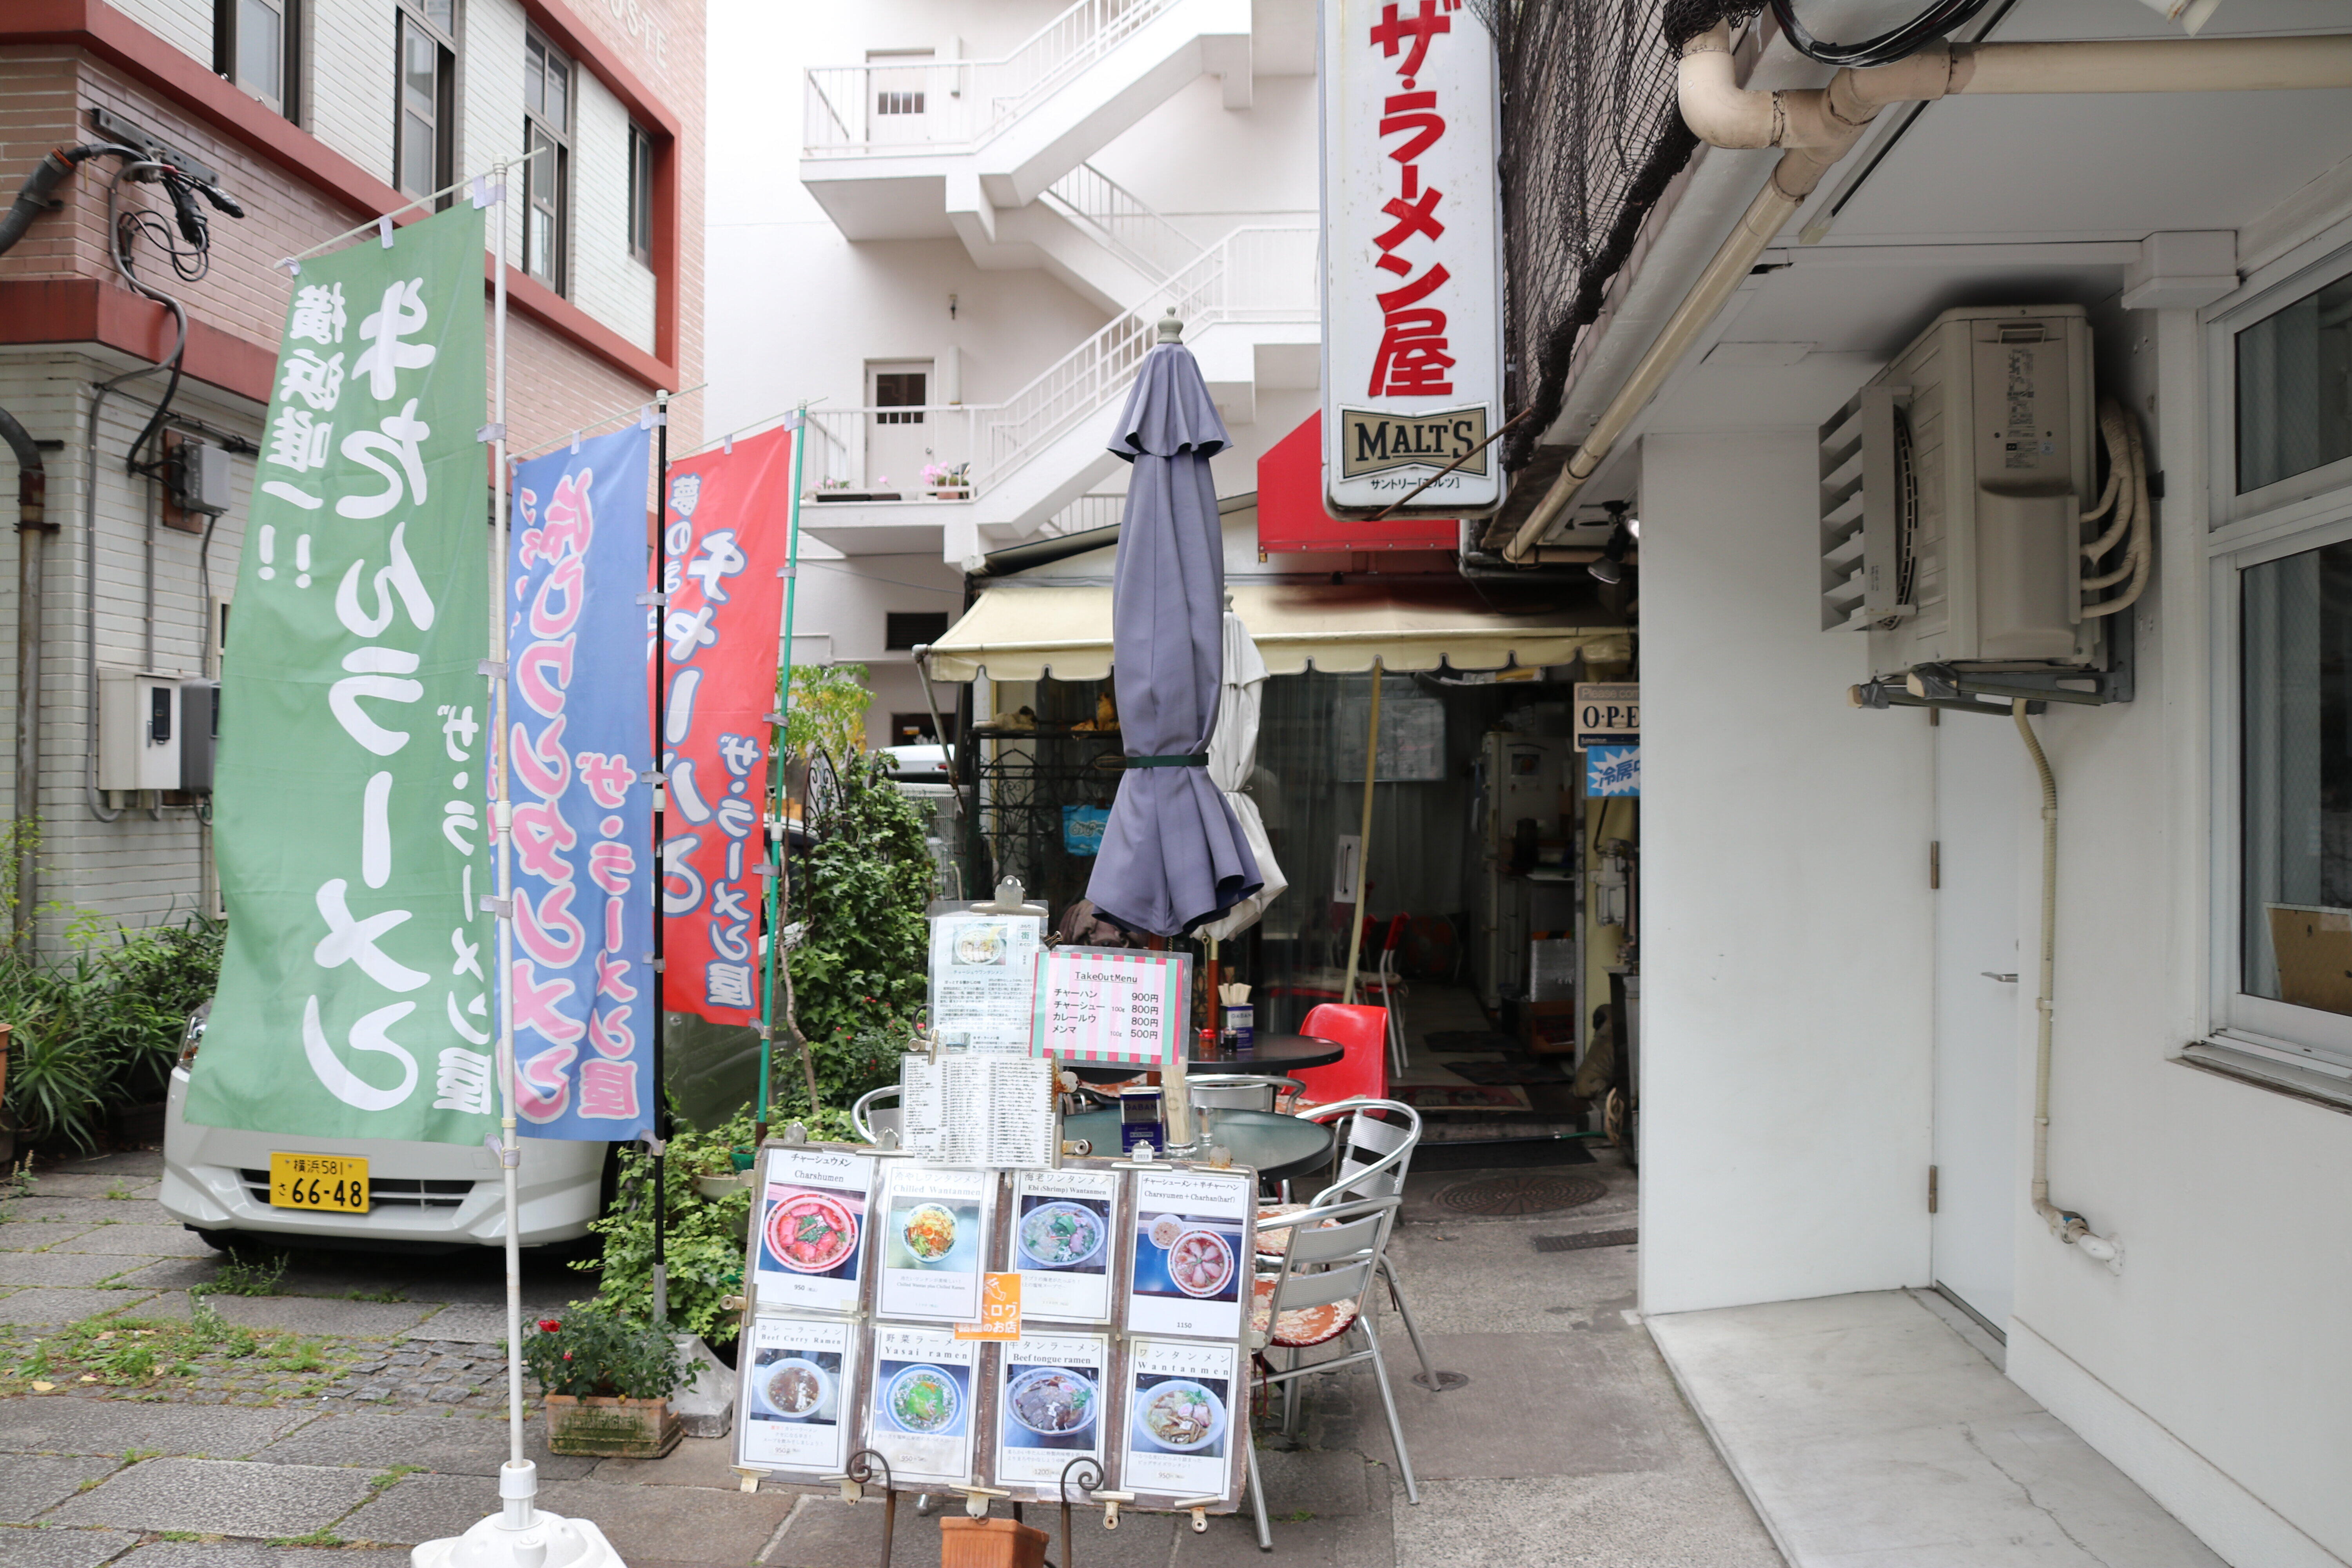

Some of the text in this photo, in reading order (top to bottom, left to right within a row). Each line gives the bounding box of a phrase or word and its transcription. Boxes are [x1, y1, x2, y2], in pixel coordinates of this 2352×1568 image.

[1368, 0, 1461, 397] ザ・ラーメン屋
[1355, 418, 1474, 461] MALT'S
[1583, 688, 1617, 698] Please
[1075, 971, 1138, 983] TakeOutMenu
[1054, 988, 1159, 1003] チャーハン 900円
[1054, 1000, 1105, 1011] チャーシュー
[1131, 1005, 1159, 1015] 800円
[1053, 1012, 1159, 1027] カレールウ 800円
[1052, 1025, 1076, 1034] メンマ
[1130, 1029, 1158, 1040] 500円
[791, 1153, 852, 1167] チャーシュウメン
[795, 1169, 844, 1183] Charshumen
[895, 1171, 982, 1183] 冷やしワンタンメン
[1024, 1172, 1108, 1185] 海老ワンタンメン
[278, 1178, 362, 1207] さ 66-48
[893, 1184, 981, 1196] Chilled Wantanmen
[1040, 1185, 1068, 1194] (Shrimp)
[1069, 1187, 1107, 1195] Wantanmen
[760, 1324, 842, 1336] カレーラーメン
[784, 1335, 808, 1344] Curry
[886, 1334, 968, 1347] 野菜ラーメン
[885, 1346, 967, 1359] Yasai ramen
[1013, 1353, 1032, 1362] Beef
[1034, 1355, 1062, 1364] tongue
[1140, 1349, 1230, 1363] ワンタンメン
